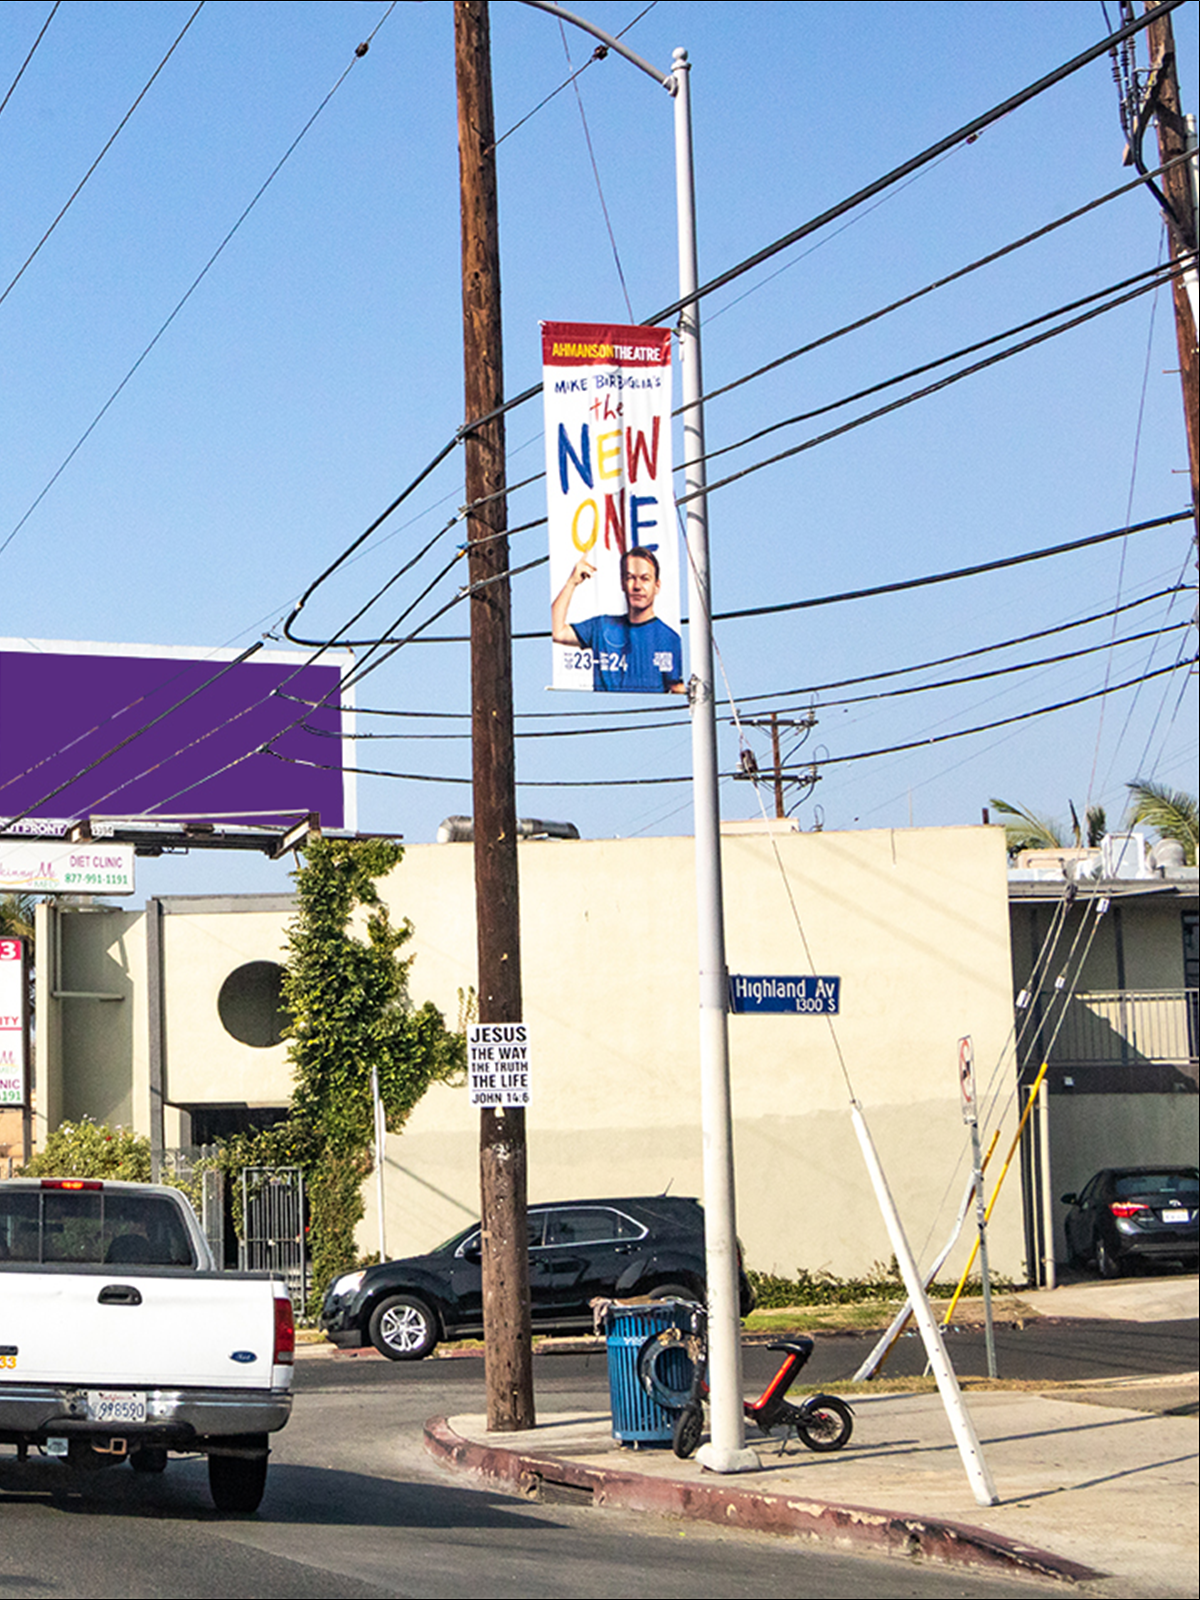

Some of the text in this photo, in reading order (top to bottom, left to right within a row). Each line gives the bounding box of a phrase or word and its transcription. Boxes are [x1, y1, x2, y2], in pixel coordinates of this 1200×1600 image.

[554, 378, 587, 394] MIKE
[590, 393, 624, 422] the
[558, 415, 661, 495] NEW
[571, 487, 659, 555] ONE
[70, 855, 123, 868] DIET CLINIC
[64, 873, 128, 885] 877-991-1191
[735, 978, 835, 1005] Highland Av
[796, 998, 836, 1012] 1300 S
[470, 1026, 527, 1043] JESUS
[471, 1047, 527, 1060] THE WAY
[471, 1061, 528, 1072] THE TRUTH
[472, 1074, 528, 1088] THE LIFE
[472, 1092, 529, 1104] JOHN 14:6
